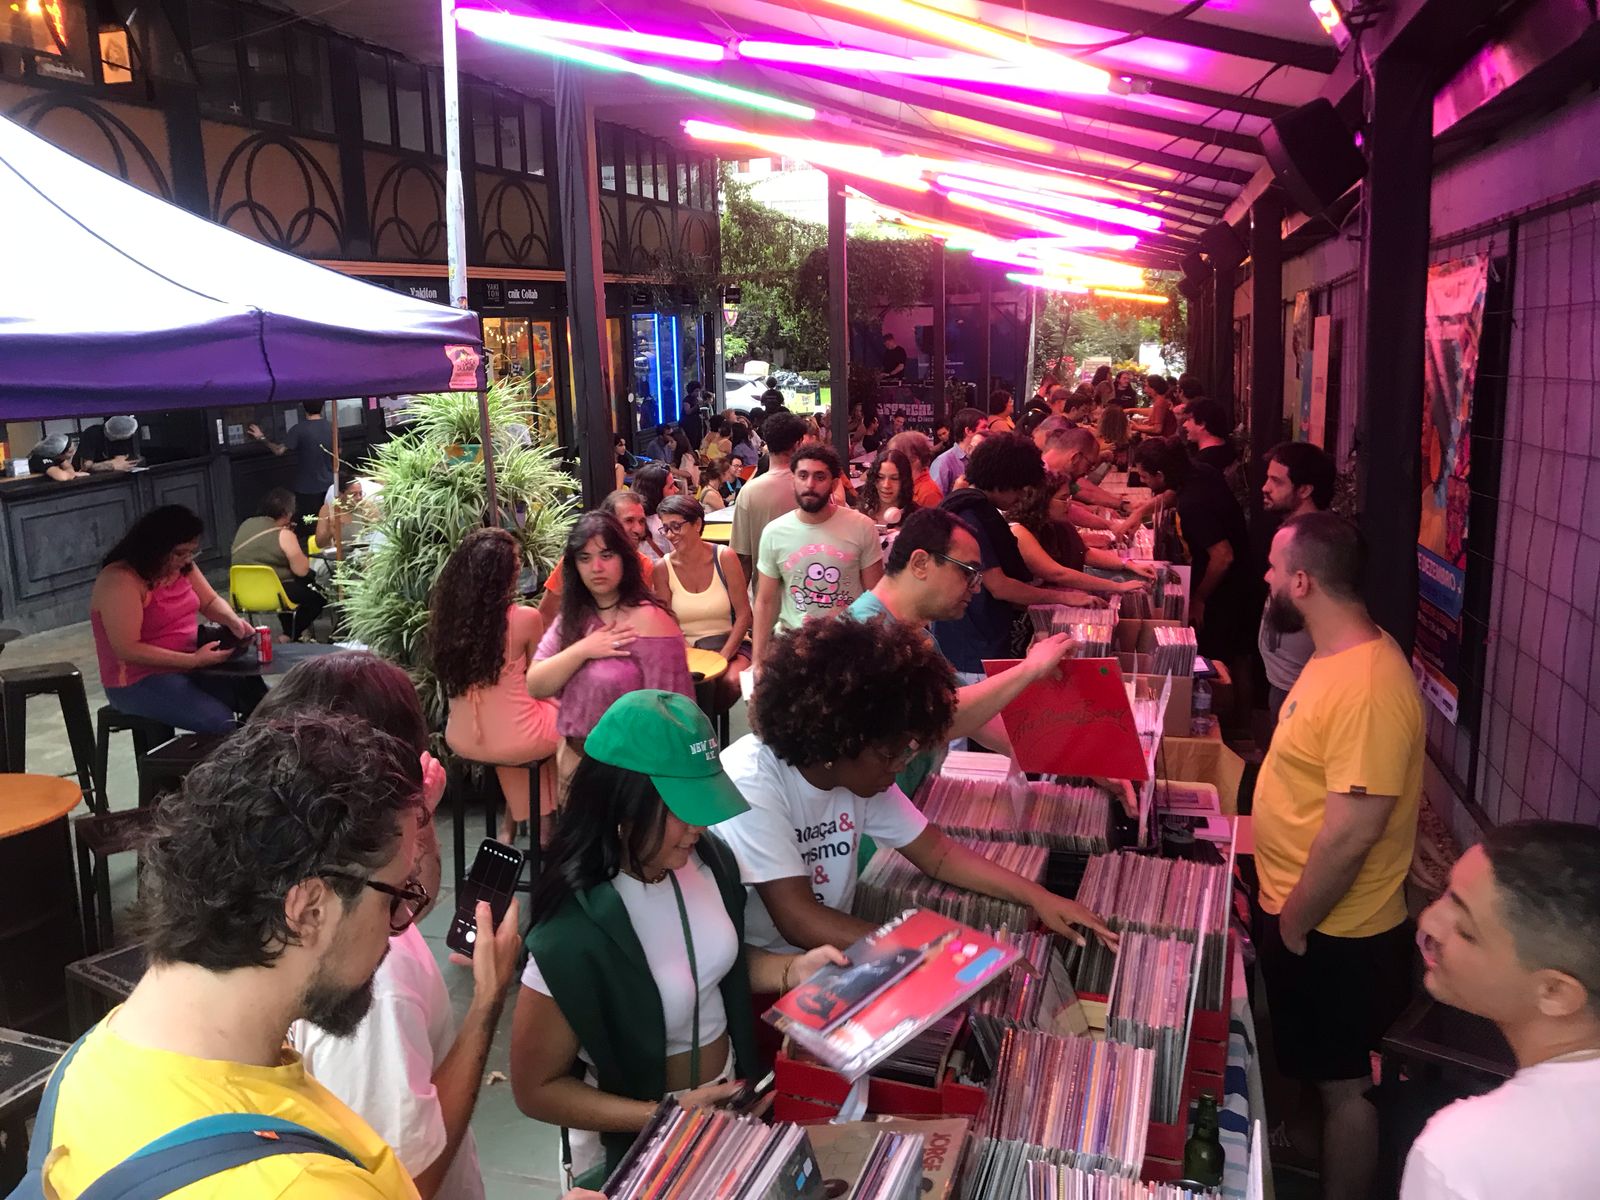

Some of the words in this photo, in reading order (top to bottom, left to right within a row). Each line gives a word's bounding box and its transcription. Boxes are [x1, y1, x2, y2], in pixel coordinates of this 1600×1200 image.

[521, 288, 538, 299] Collab
[689, 740, 707, 755] NEW
[922, 1132, 952, 1172] JORGE
